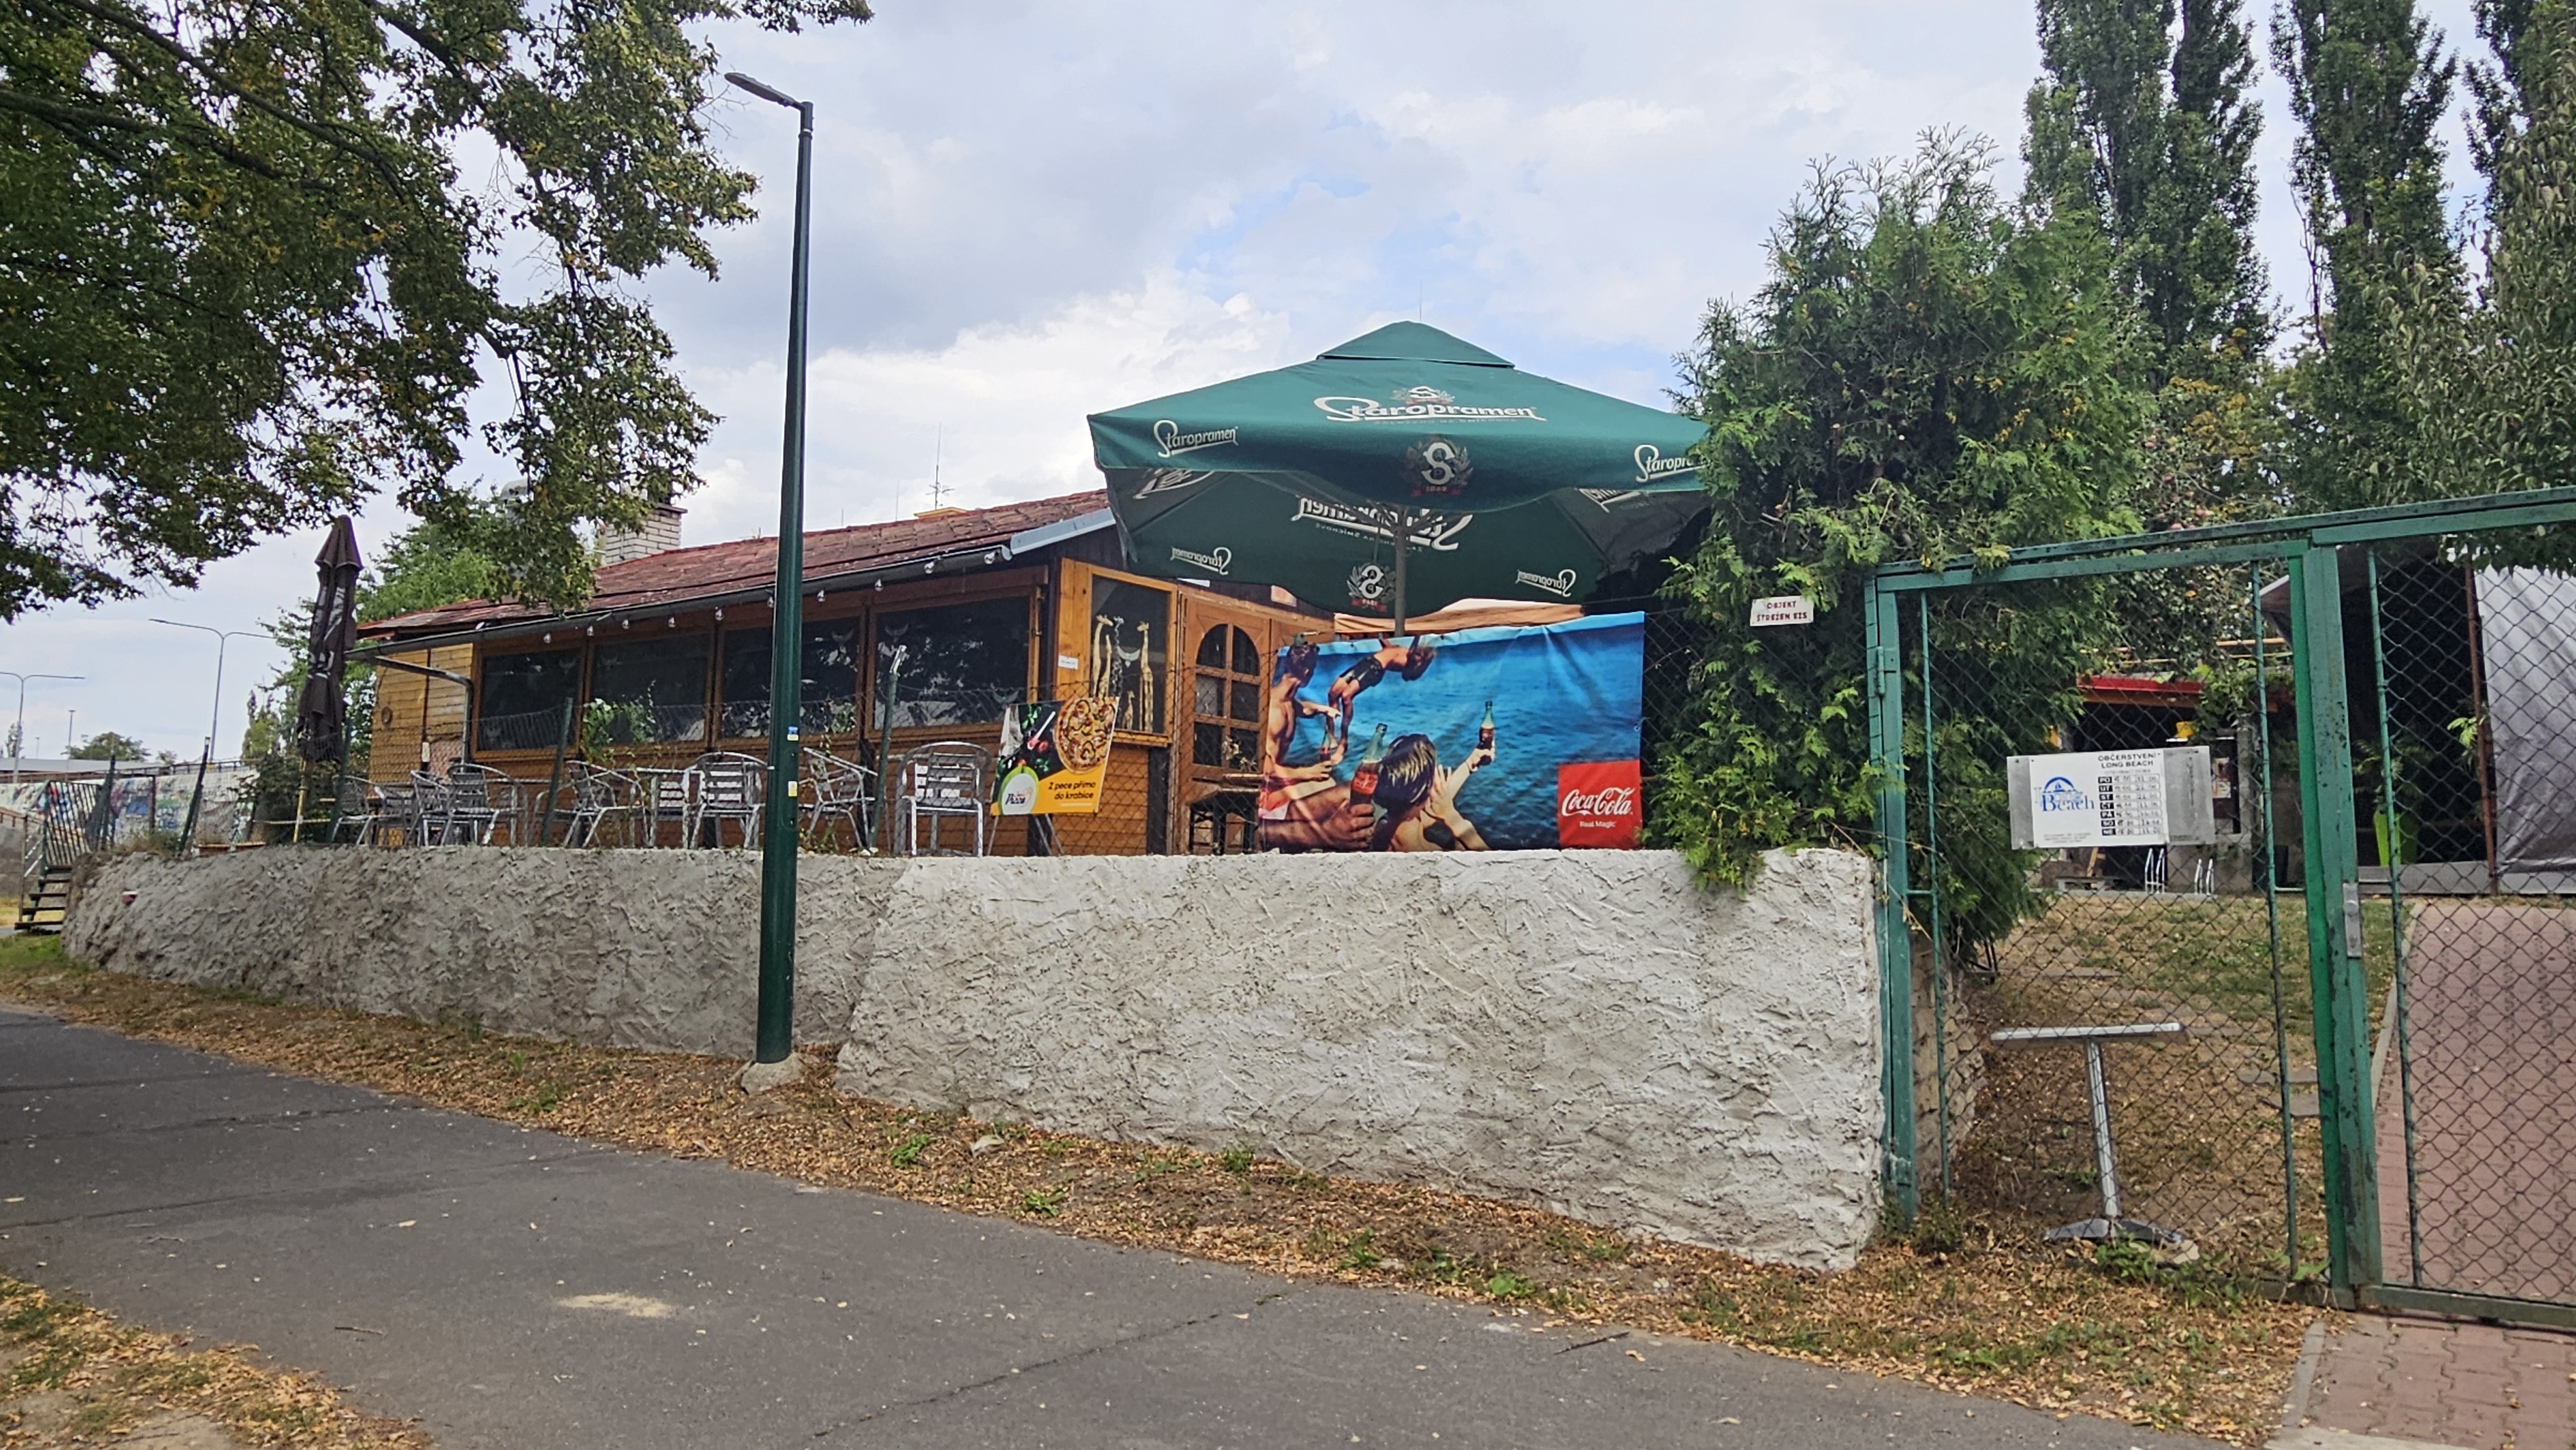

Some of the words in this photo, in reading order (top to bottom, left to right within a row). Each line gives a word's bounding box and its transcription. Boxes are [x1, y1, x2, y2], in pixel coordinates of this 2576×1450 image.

[1314, 397, 1547, 422] Staropramen
[1153, 419, 1238, 458] Staropramen
[1766, 601, 1797, 609] OBJEKT
[1048, 782, 1054, 790] Z
[1065, 791, 1094, 799] krabice
[1562, 787, 1636, 816] Coca-Cola
[2041, 794, 2095, 812] Beach
